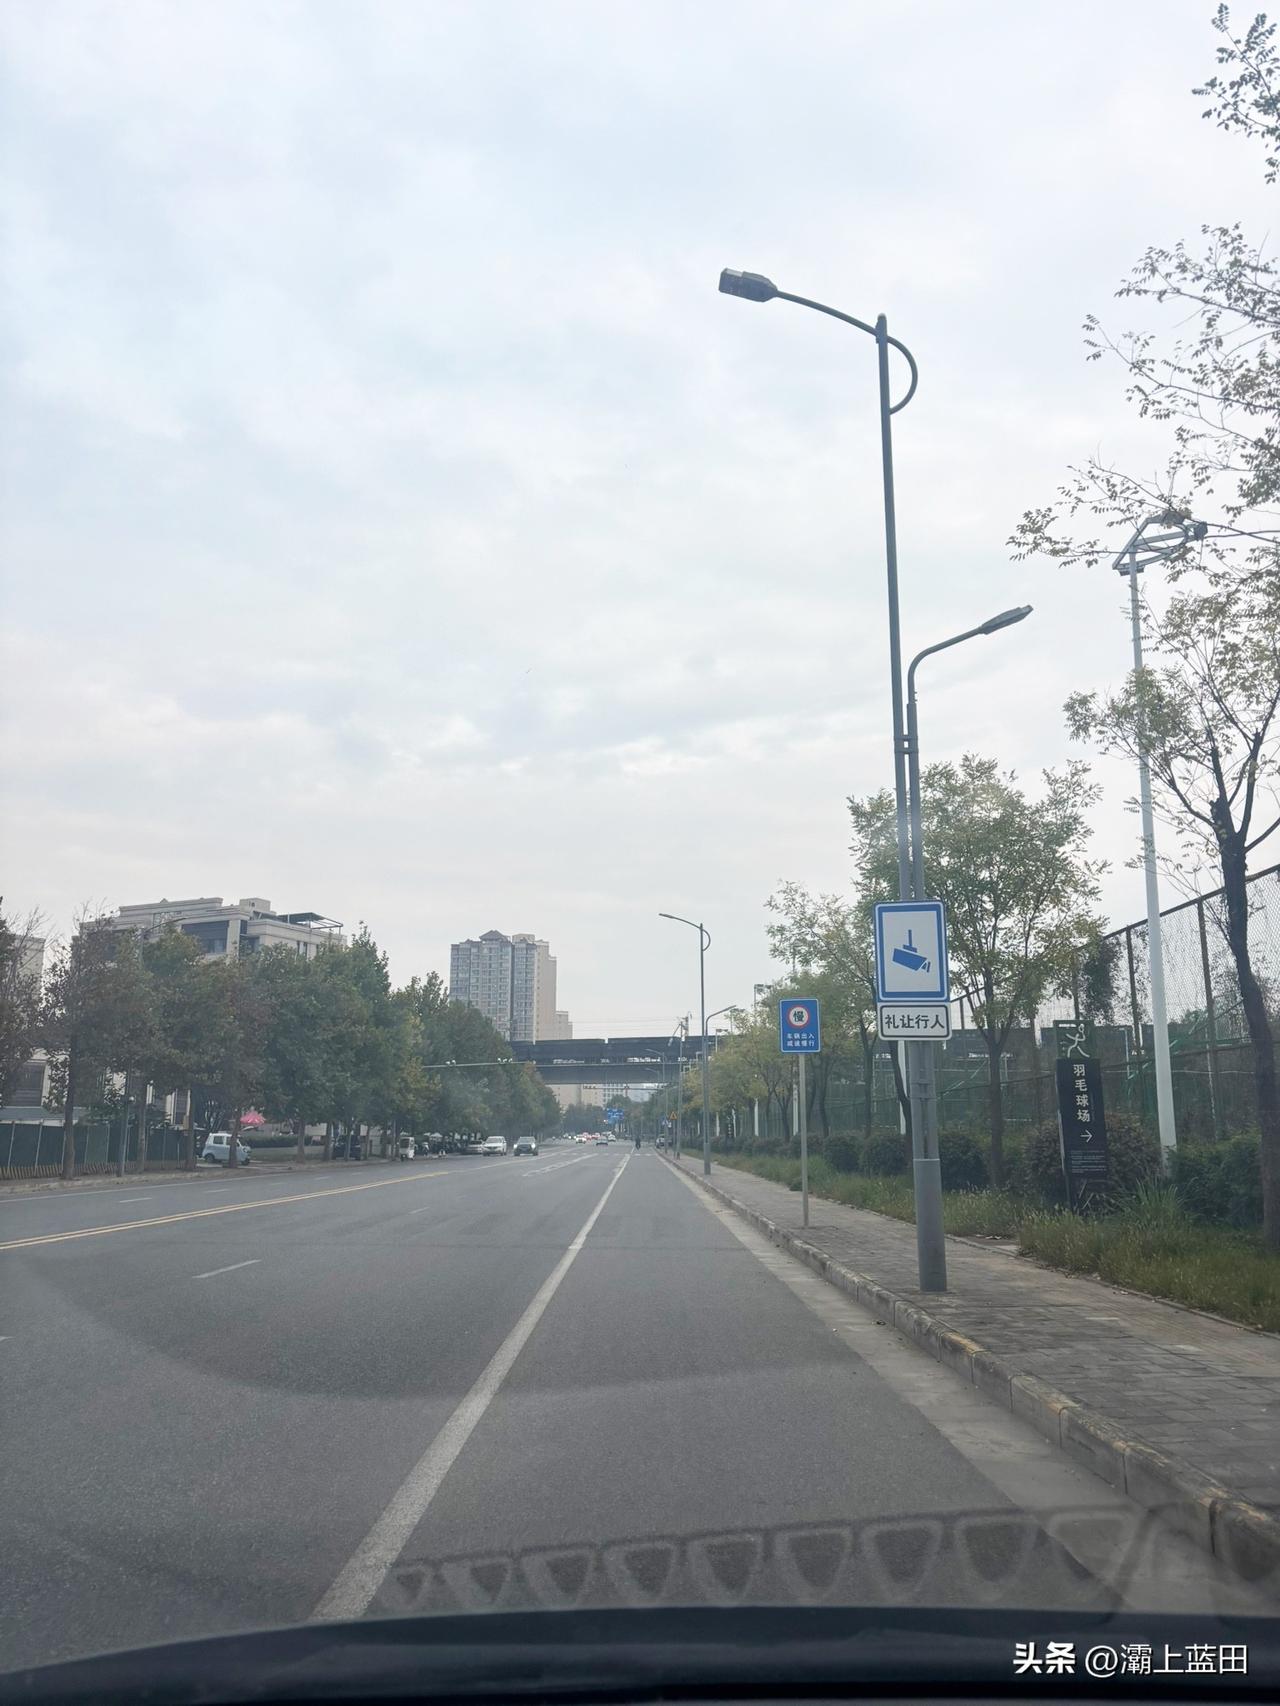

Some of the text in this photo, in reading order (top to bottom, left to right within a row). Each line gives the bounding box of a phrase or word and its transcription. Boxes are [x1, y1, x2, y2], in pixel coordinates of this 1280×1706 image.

[793, 1010, 804, 1022] 慢
[884, 1014, 945, 1029] 礼让行人
[1073, 1063, 1091, 1123] 羽毛球场
